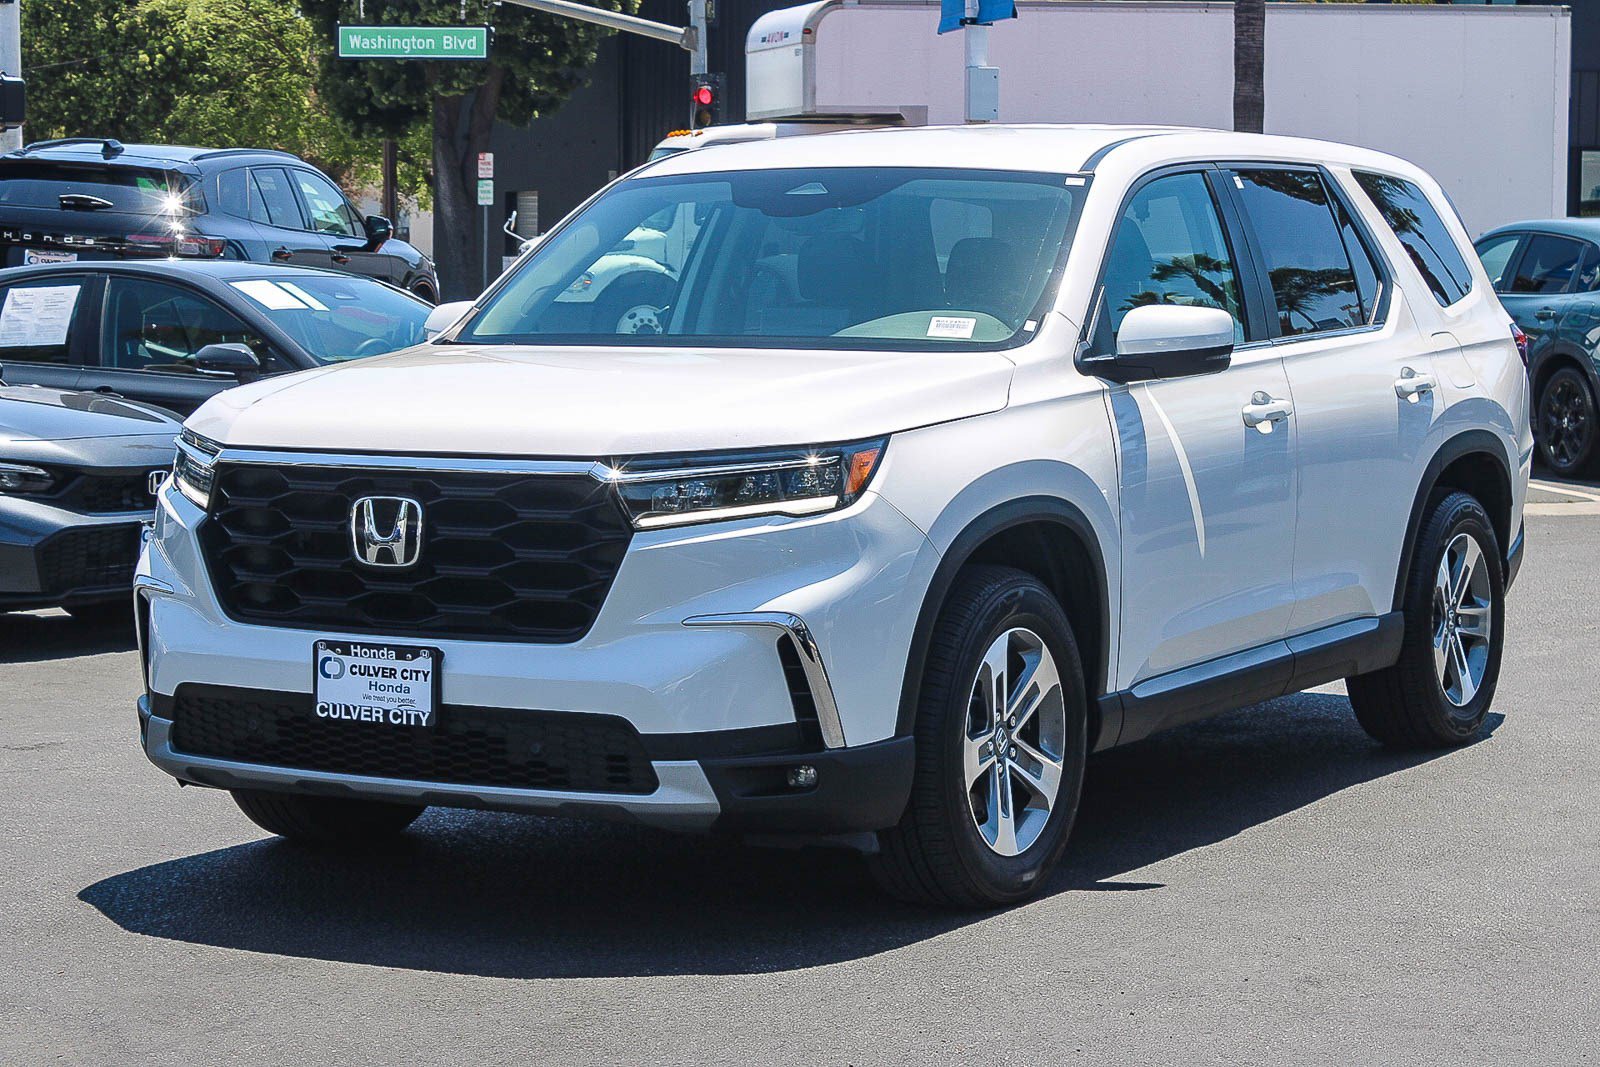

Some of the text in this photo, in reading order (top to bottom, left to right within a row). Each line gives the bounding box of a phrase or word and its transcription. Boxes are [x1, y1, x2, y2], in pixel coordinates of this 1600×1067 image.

[349, 34, 477, 53] Washington Blvd
[350, 644, 396, 660] Honda
[349, 664, 430, 682] CULVER CITY
[368, 680, 411, 694] Honda
[362, 693, 372, 701] We
[386, 696, 397, 704] you
[316, 702, 430, 727] CULVER CITY
